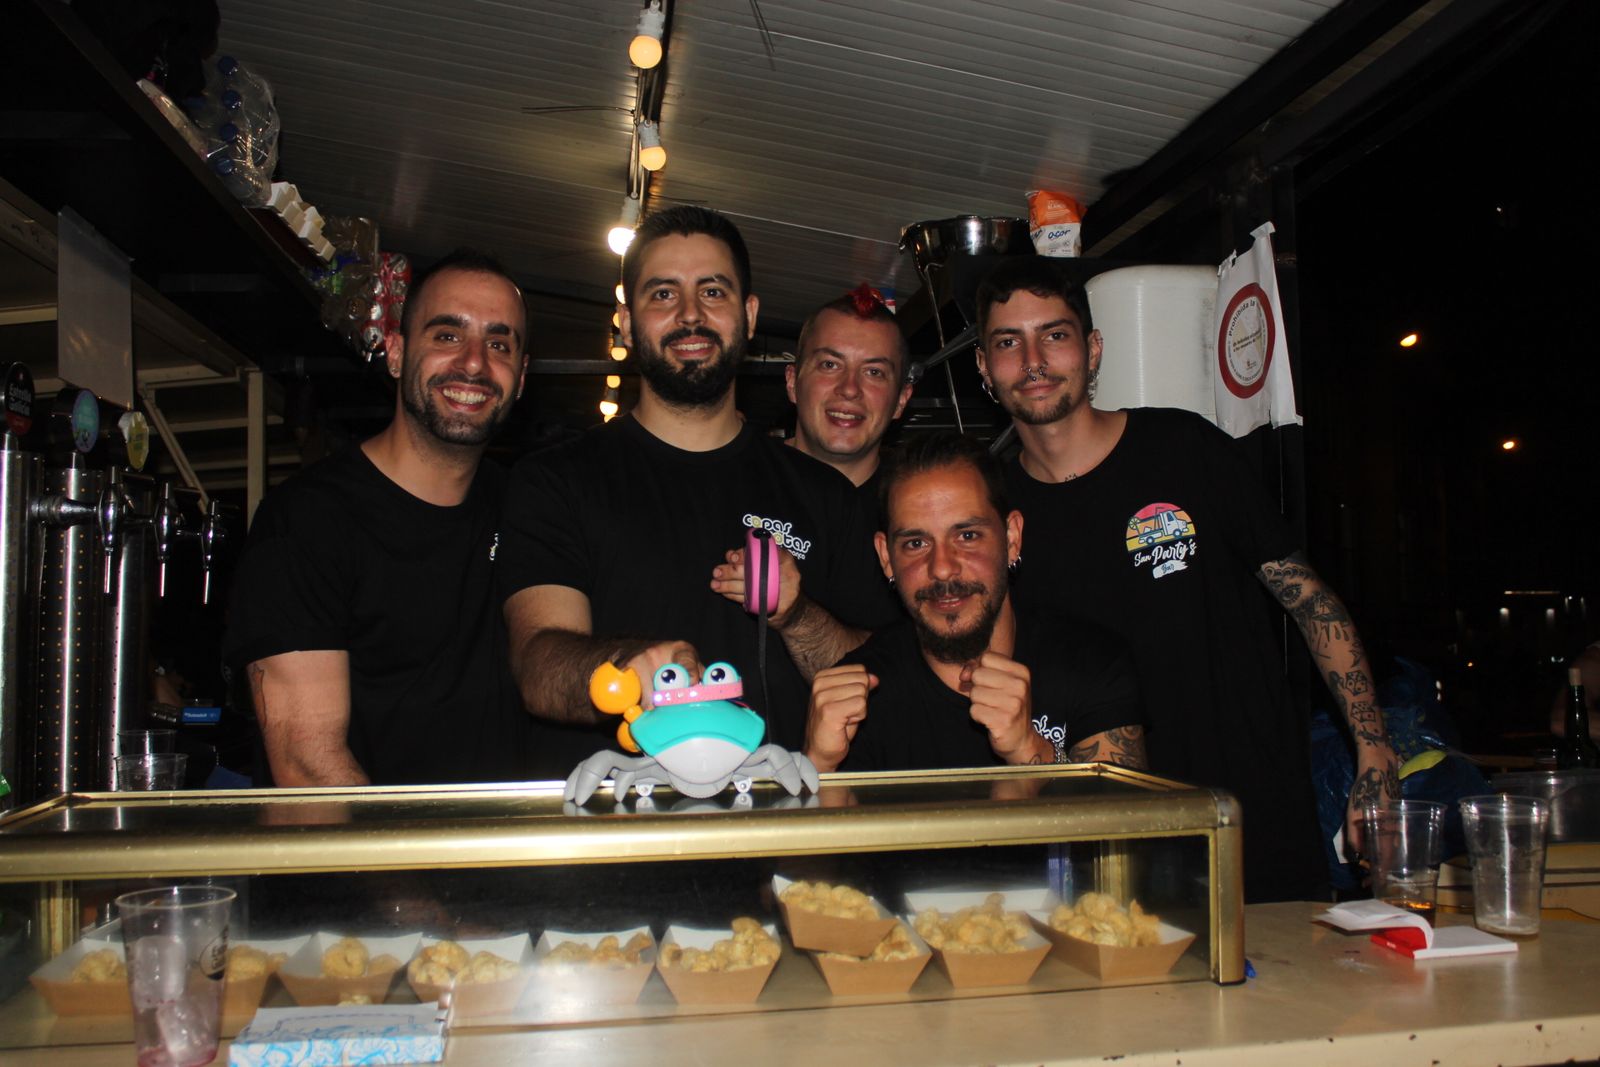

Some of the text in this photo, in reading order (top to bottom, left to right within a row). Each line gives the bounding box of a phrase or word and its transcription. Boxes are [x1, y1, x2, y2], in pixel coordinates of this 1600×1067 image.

[1228, 303, 1249, 337] Prohibida
[769, 529, 812, 554] otas
[1151, 538, 1197, 566] Party's
